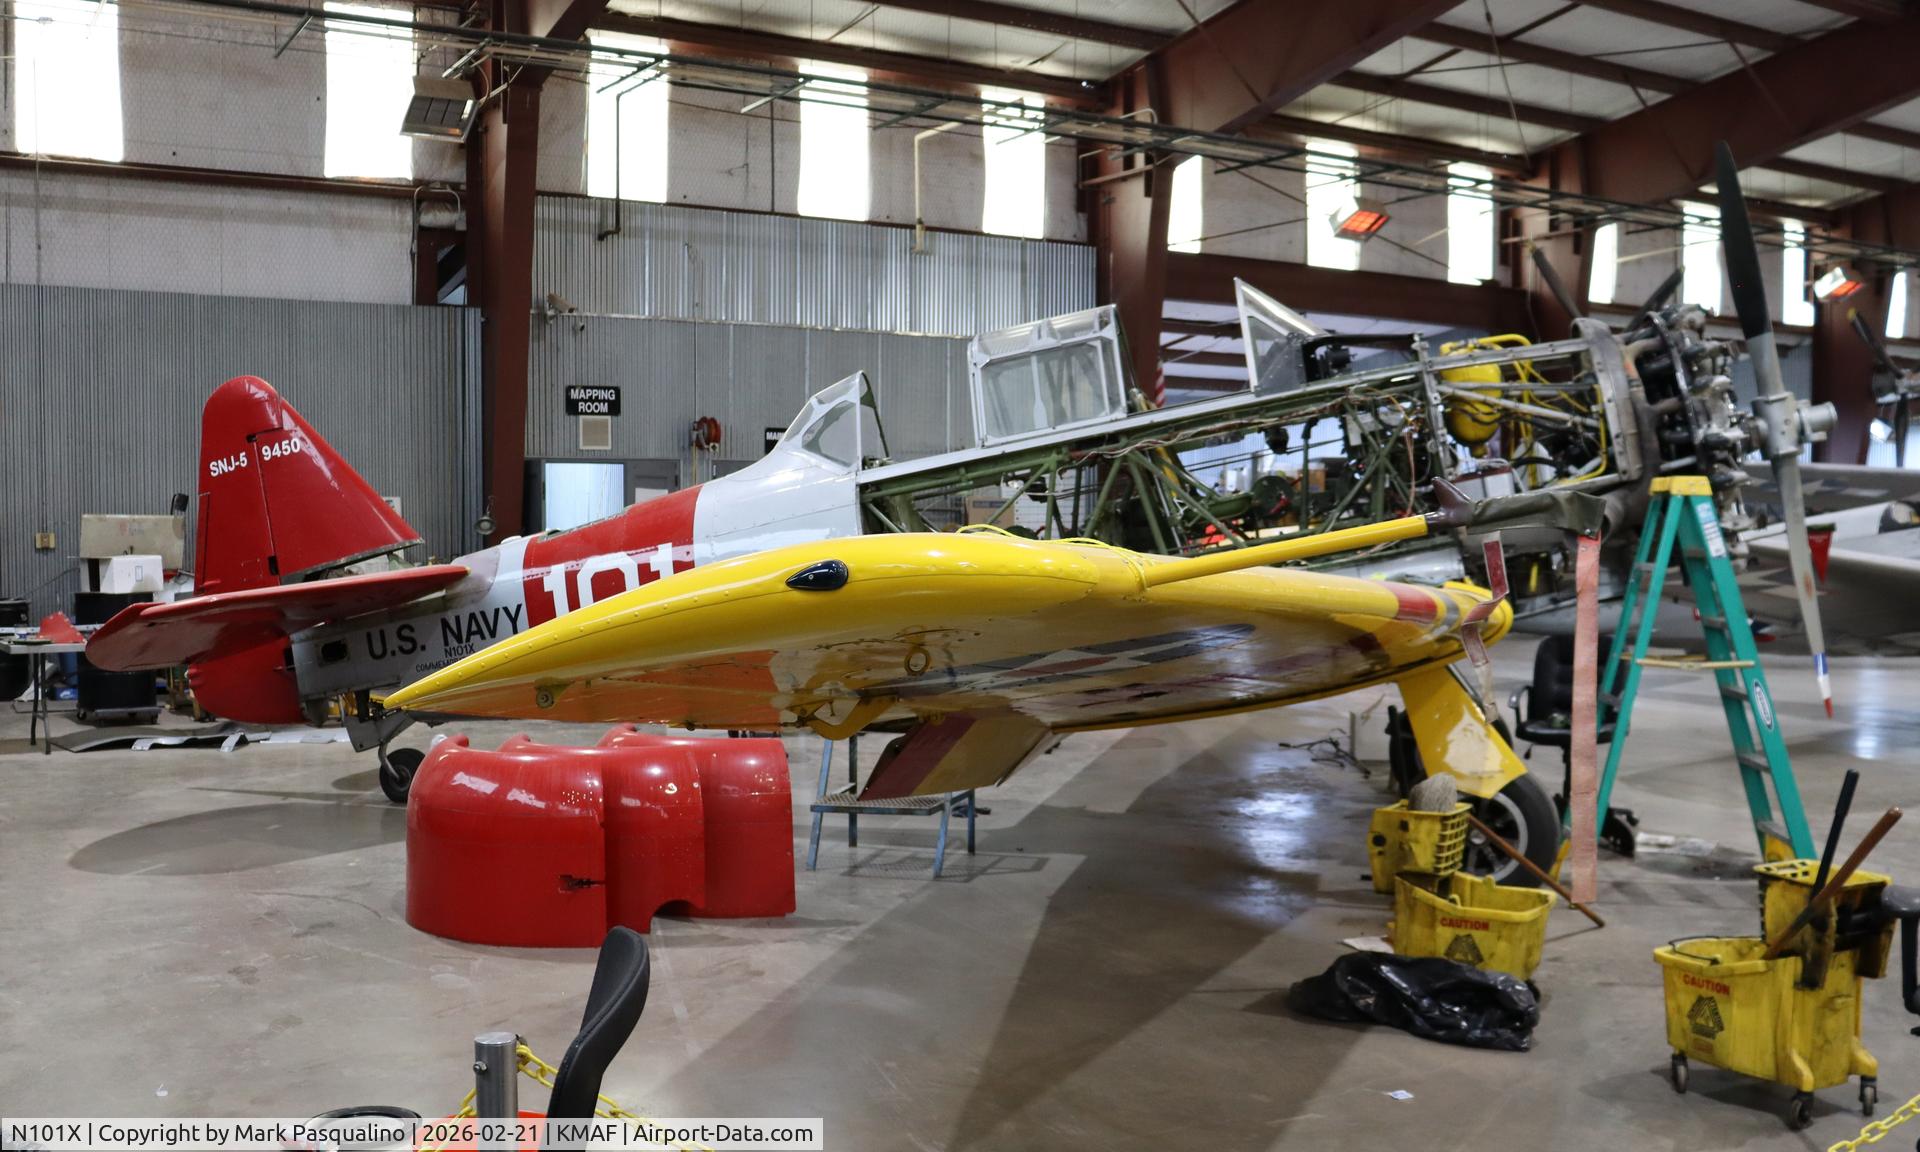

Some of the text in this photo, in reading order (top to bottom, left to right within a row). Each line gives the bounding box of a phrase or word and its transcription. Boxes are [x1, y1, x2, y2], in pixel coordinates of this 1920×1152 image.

[570, 388, 616, 401] MAPPING
[578, 401, 609, 413] ROOM
[209, 437, 301, 477] SNJ-5 9450
[366, 603, 523, 660] U.S. NAVY
[444, 643, 476, 659] N101X
[1440, 917, 1490, 931] CAUTION
[1683, 973, 1731, 997] CAUTION
